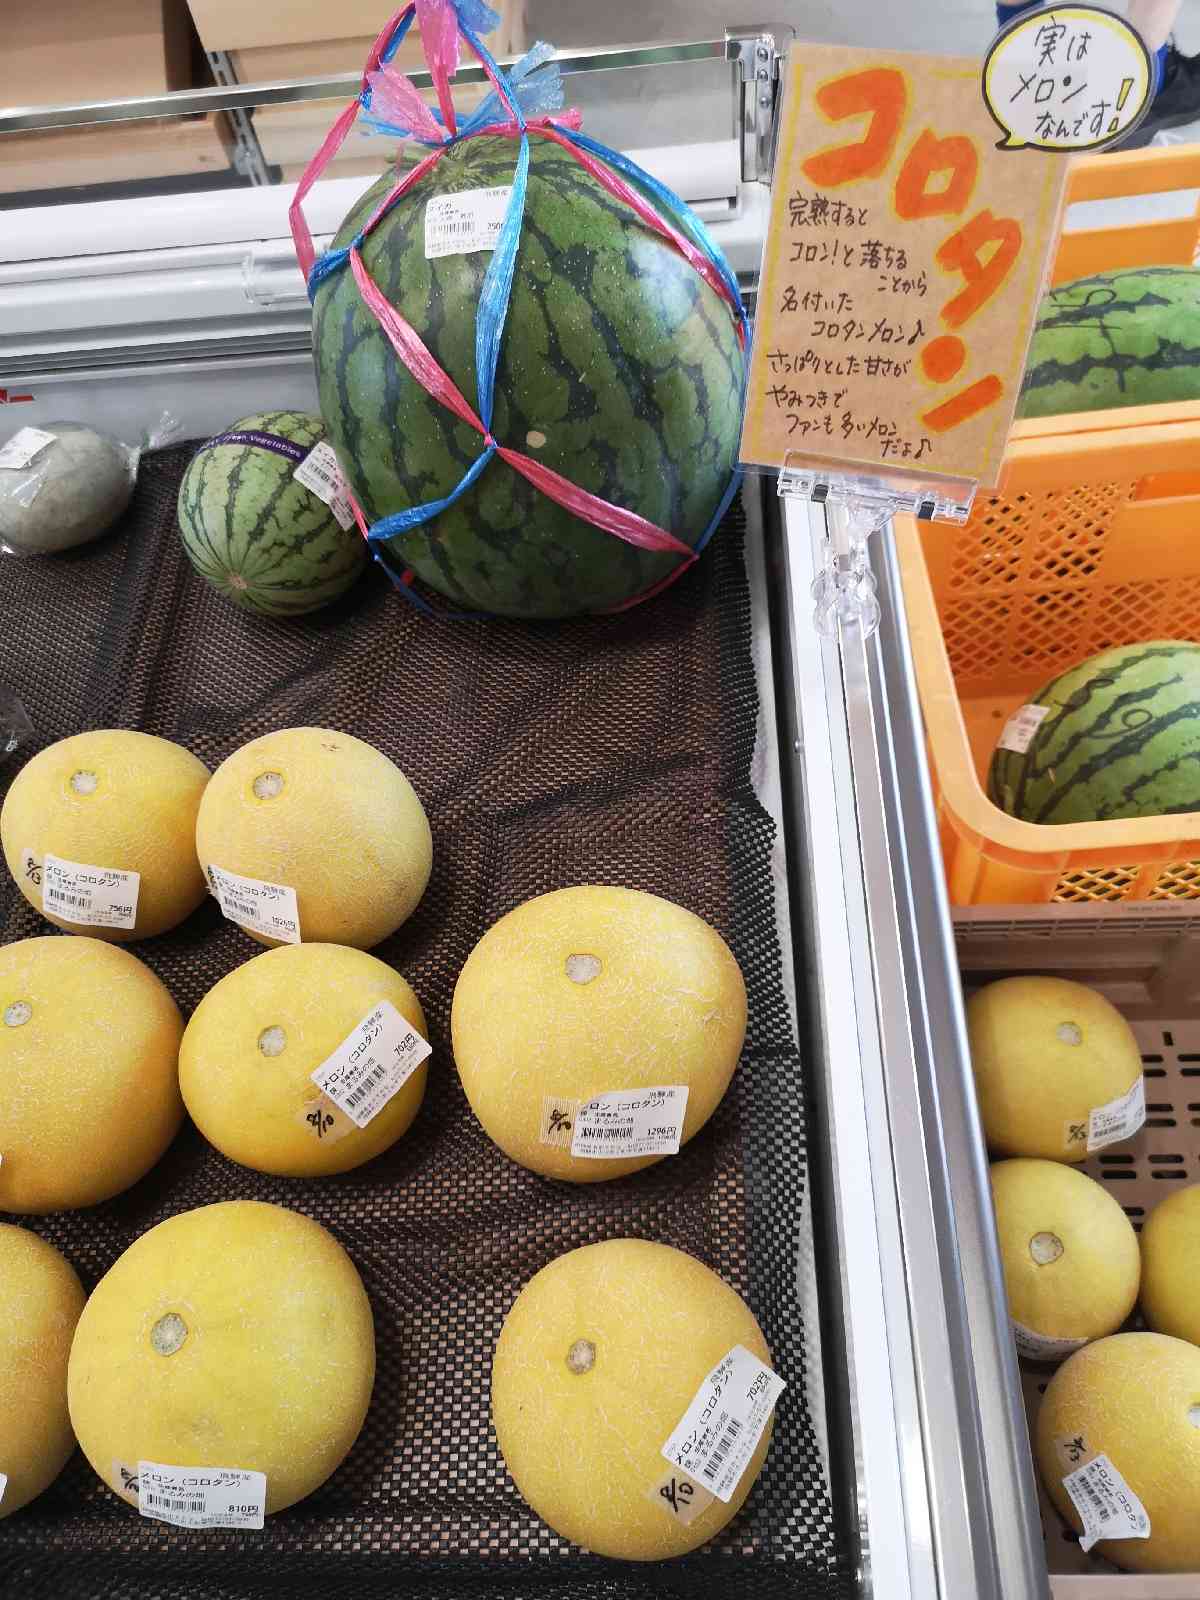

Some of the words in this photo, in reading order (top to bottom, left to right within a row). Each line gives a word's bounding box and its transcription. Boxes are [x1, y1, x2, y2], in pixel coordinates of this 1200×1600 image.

[1034, 15, 1092, 67] 実は
[1010, 71, 1087, 104] メロン
[788, 190, 868, 227] 完熟すると
[802, 66, 1022, 433] コロタン
[877, 271, 928, 297] ことから
[780, 285, 854, 314] 名付いた
[765, 384, 848, 409] やみつきで
[746, 1371, 769, 1401] 702円
[228, 1504, 260, 1514] 810円
